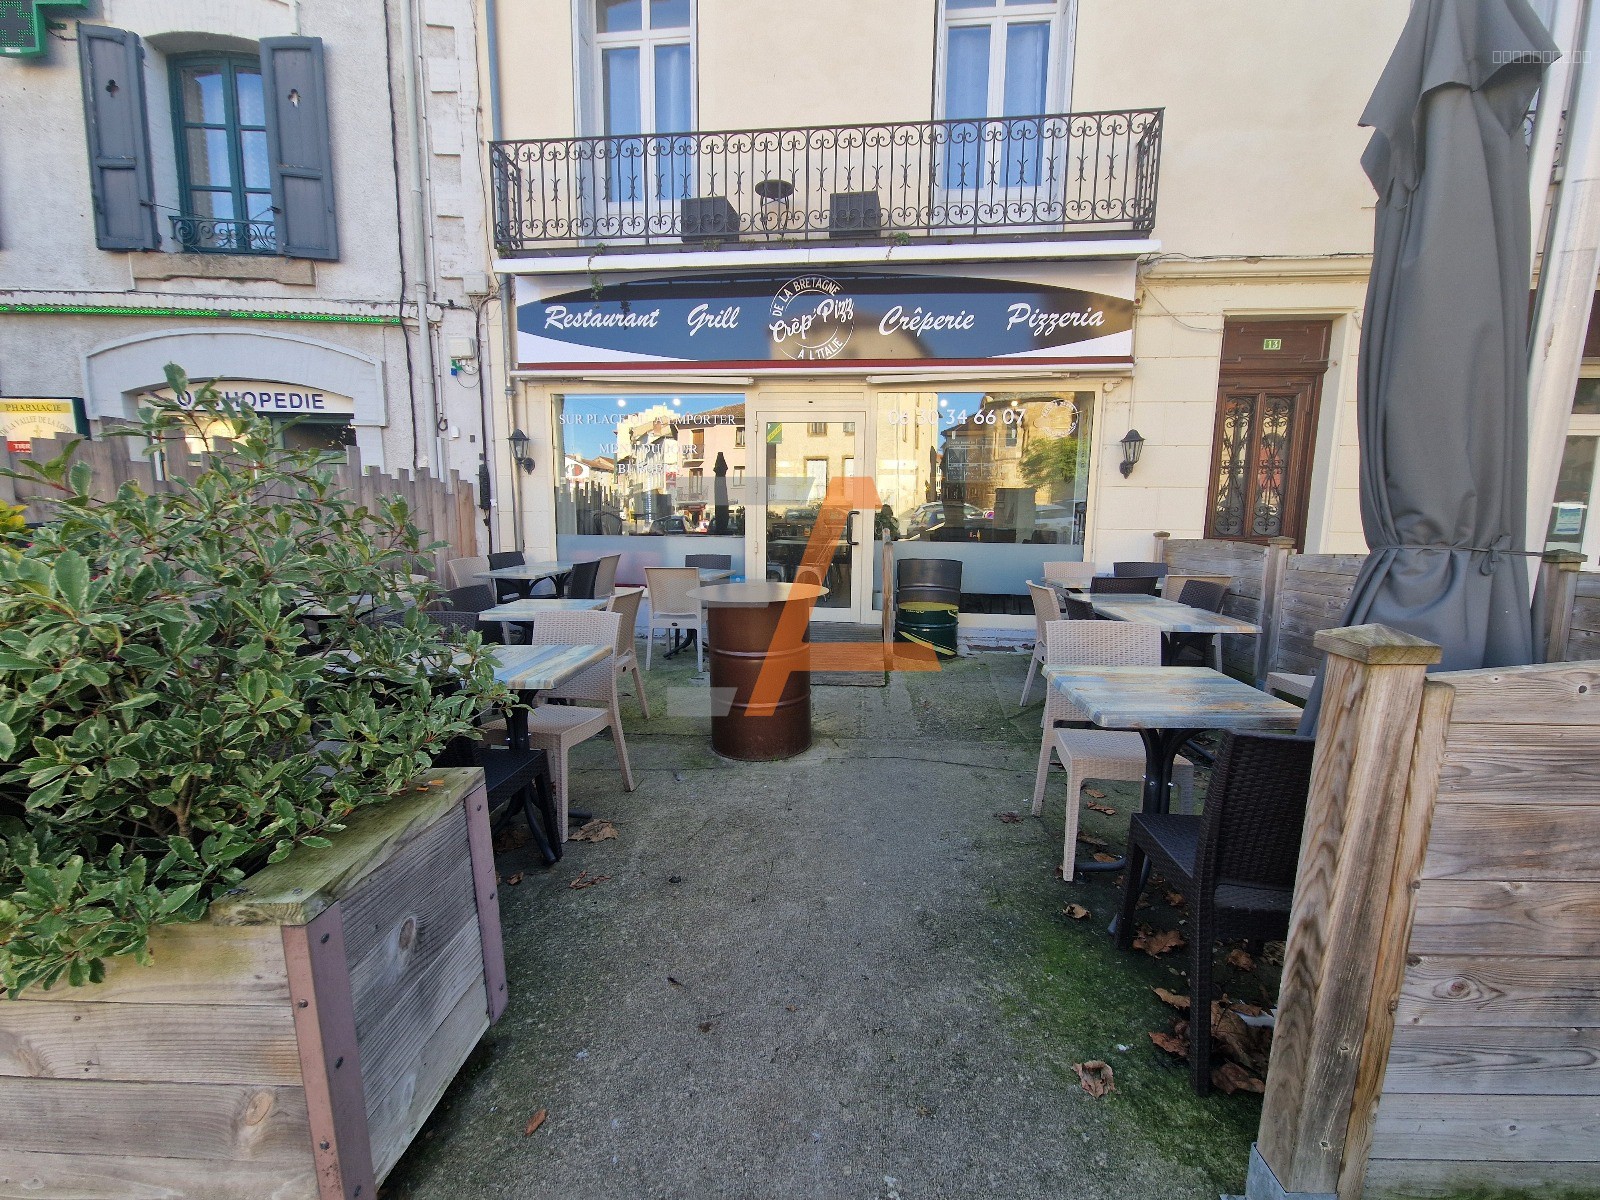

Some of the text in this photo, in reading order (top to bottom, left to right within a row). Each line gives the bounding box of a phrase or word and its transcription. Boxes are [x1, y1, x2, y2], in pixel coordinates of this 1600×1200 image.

[772, 277, 841, 317] DE LA BRETAGNE
[543, 303, 741, 337] Restaurant Grill
[878, 302, 1106, 337] Crêperie Pizzeria
[1267, 340, 1279, 349] 13
[5, 403, 62, 412] PHARMACIE
[176, 391, 325, 409] OHOPEDIE
[559, 413, 583, 425] SUR
[587, 413, 626, 425] PLACE
[669, 413, 736, 426] EMPORTER
[946, 408, 968, 425] 34
[973, 408, 997, 425] 66
[1002, 408, 1028, 425] 07
[641, 443, 661, 455] DU
